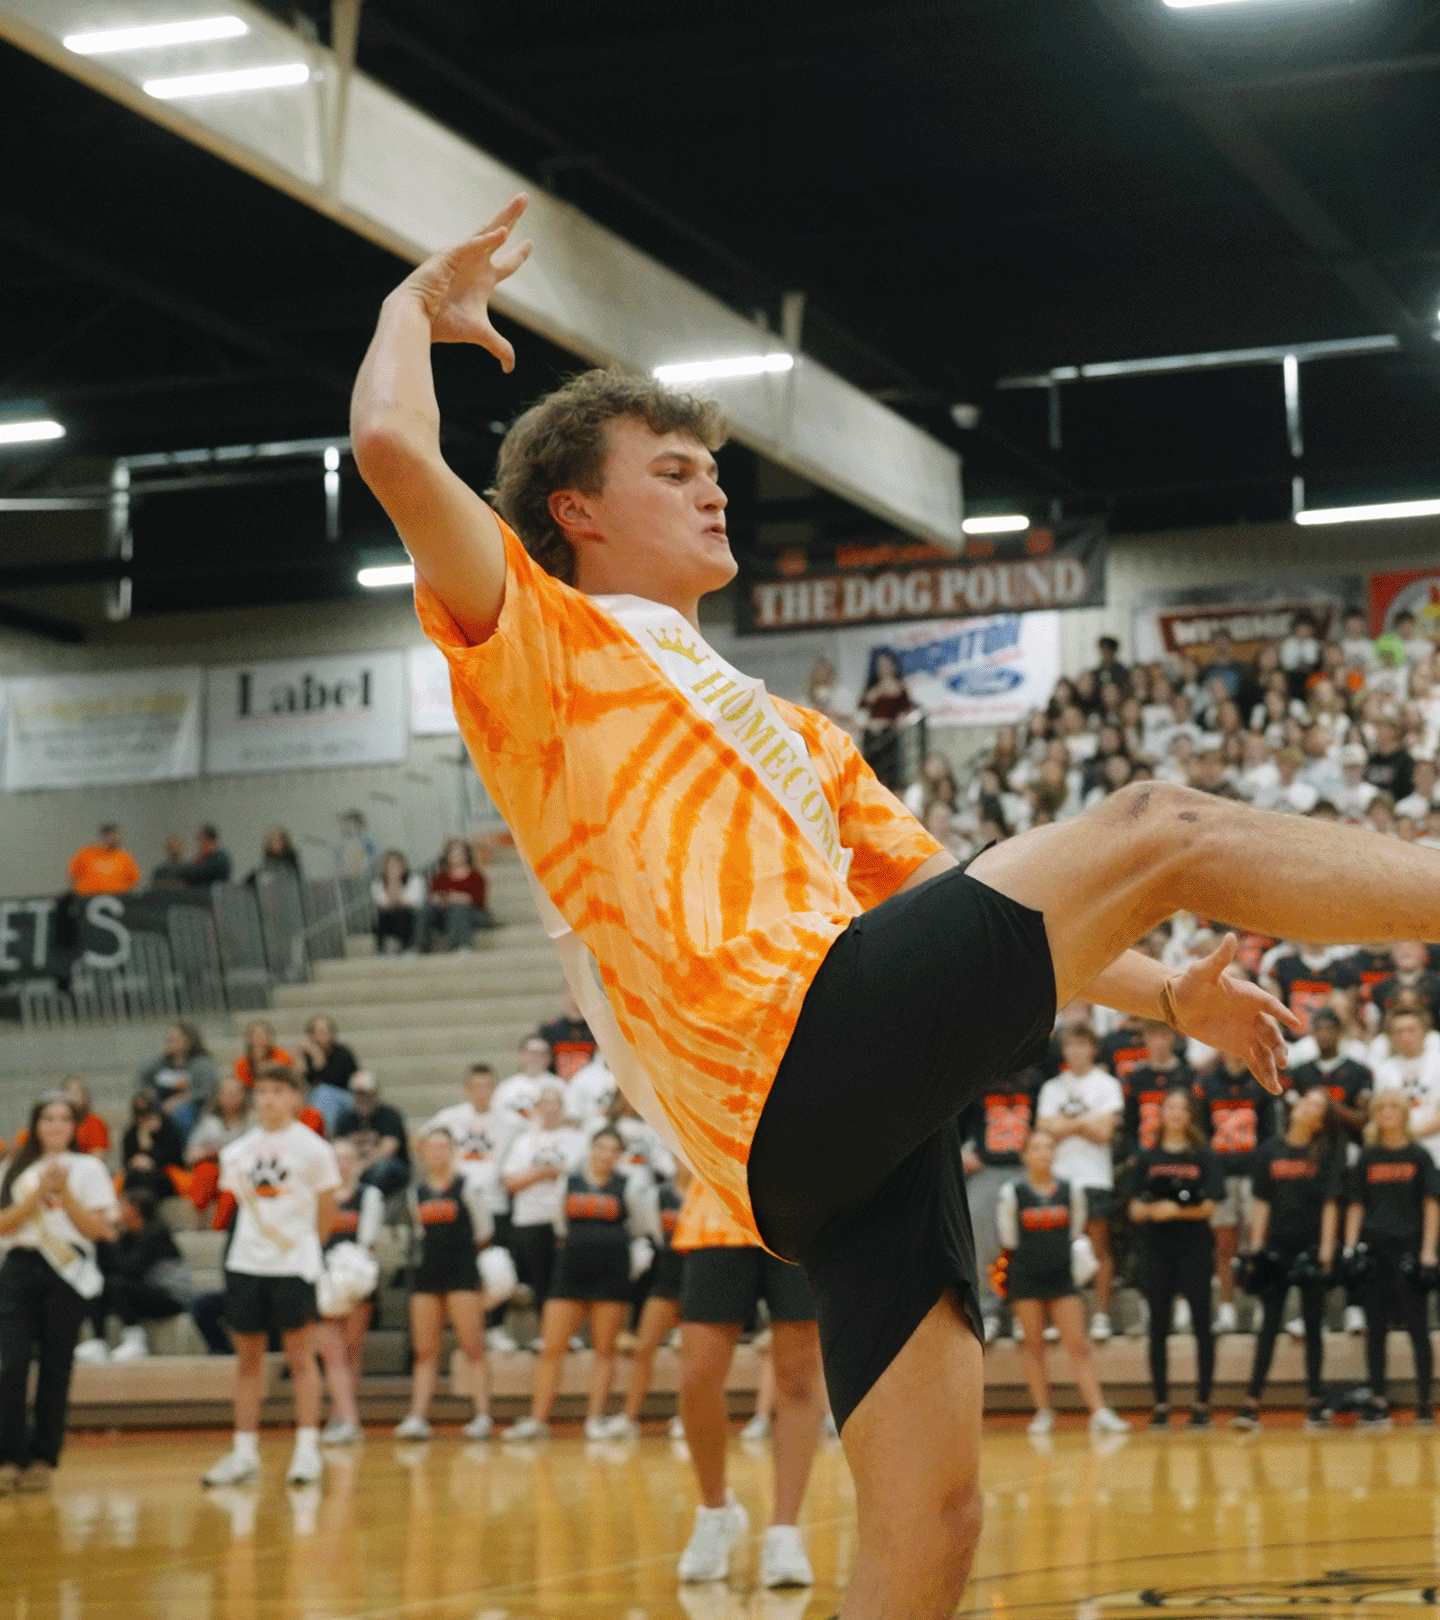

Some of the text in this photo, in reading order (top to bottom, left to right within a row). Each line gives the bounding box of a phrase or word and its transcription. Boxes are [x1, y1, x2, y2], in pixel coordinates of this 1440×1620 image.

[757, 559, 1086, 626] THE DOG POUND
[238, 669, 373, 717] Label
